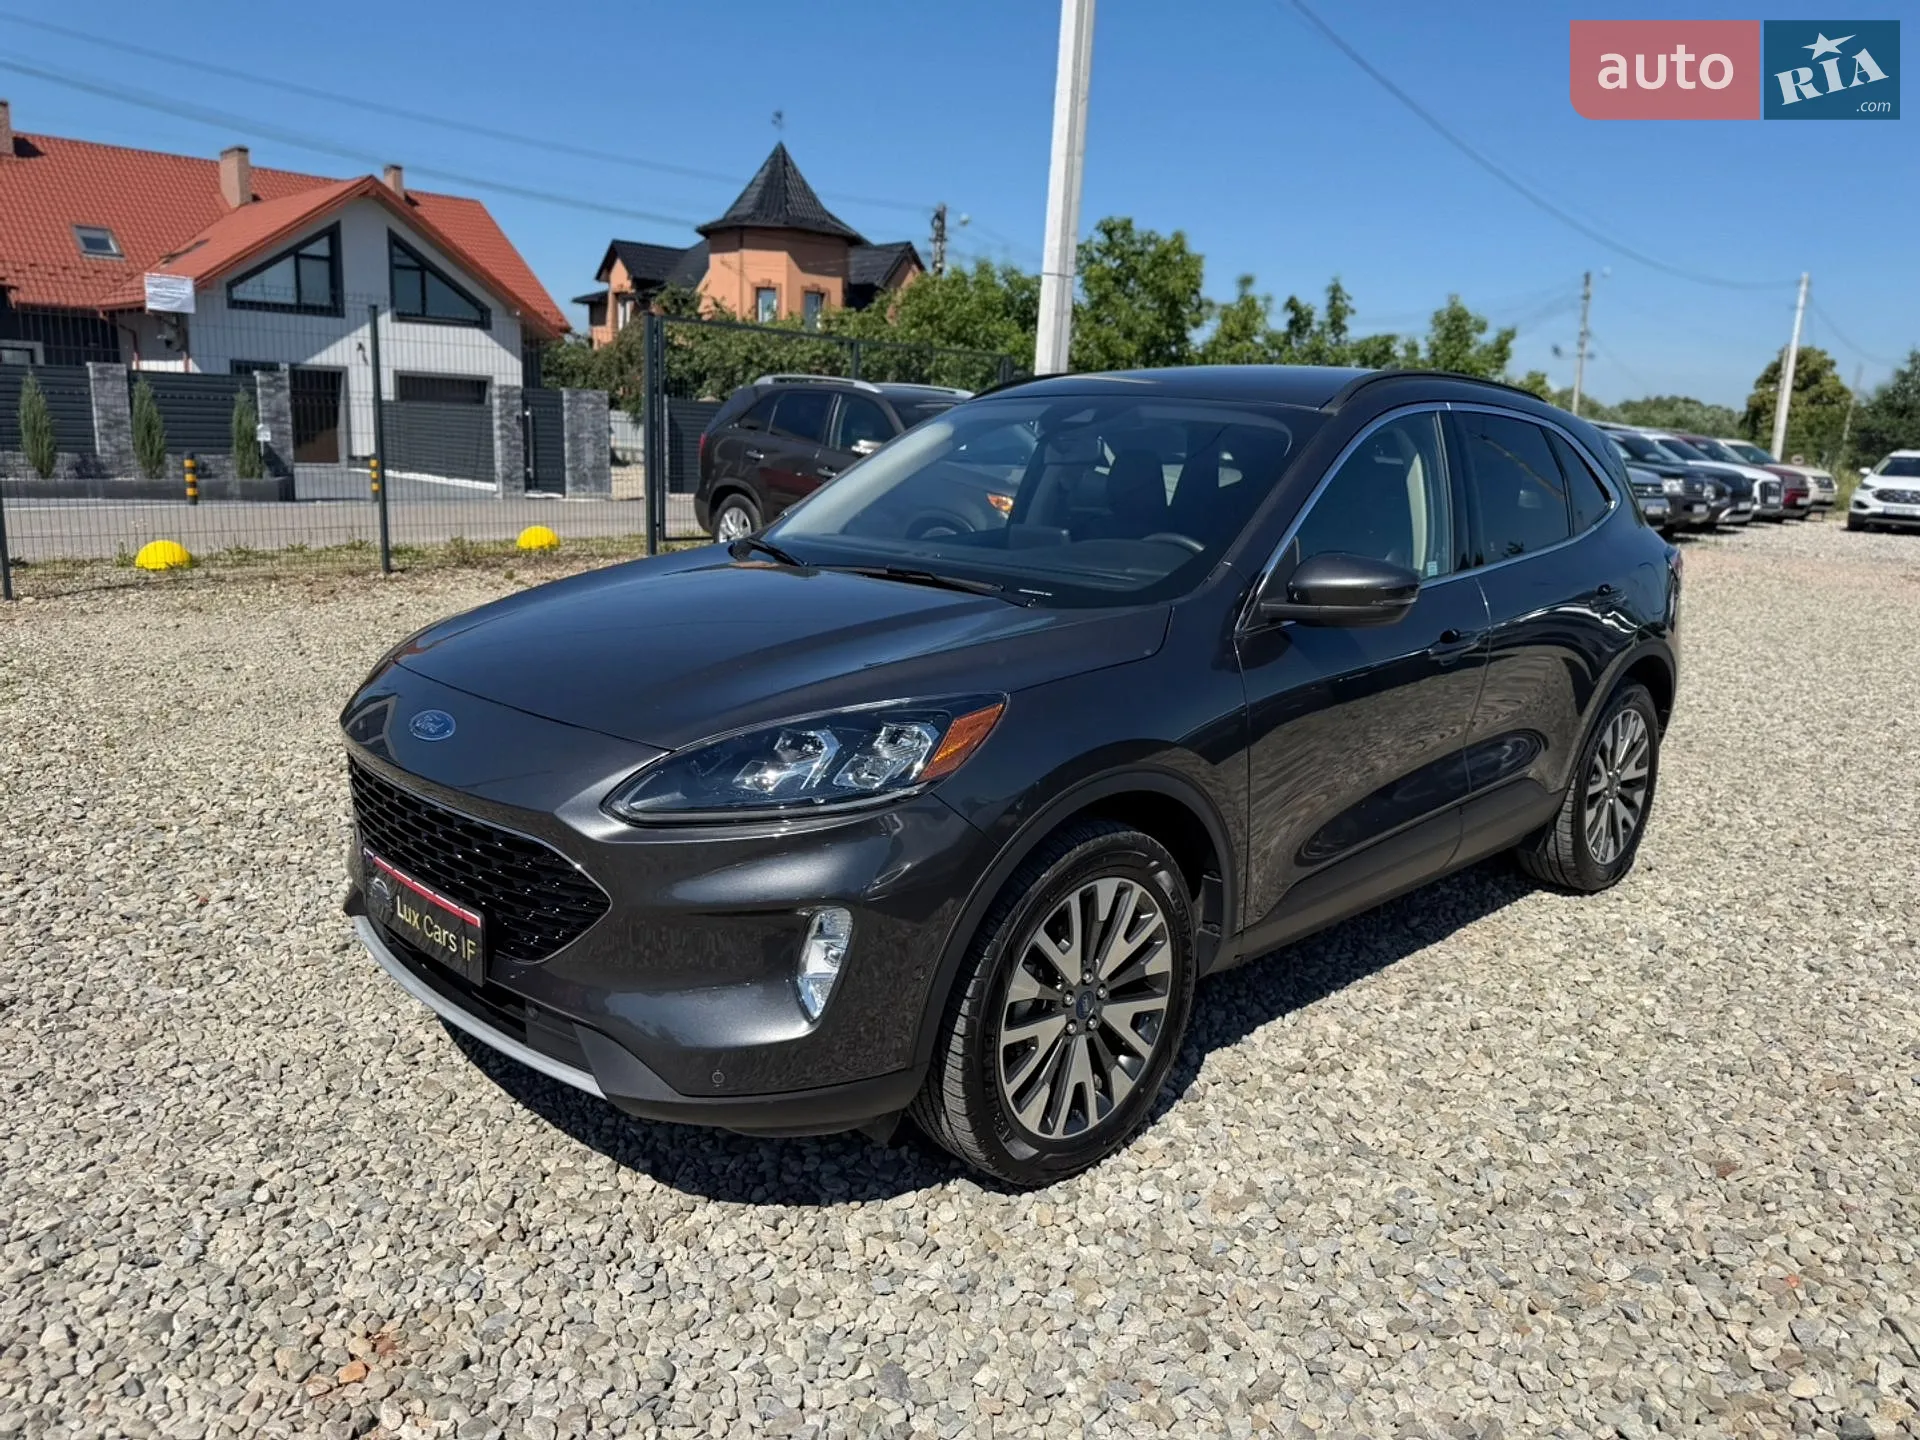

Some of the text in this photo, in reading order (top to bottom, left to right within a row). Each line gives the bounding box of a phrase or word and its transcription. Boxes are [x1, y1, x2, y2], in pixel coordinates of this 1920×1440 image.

[396, 895, 420, 930] Lux
[423, 915, 458, 953] Cars
[462, 936, 477, 961] IF
